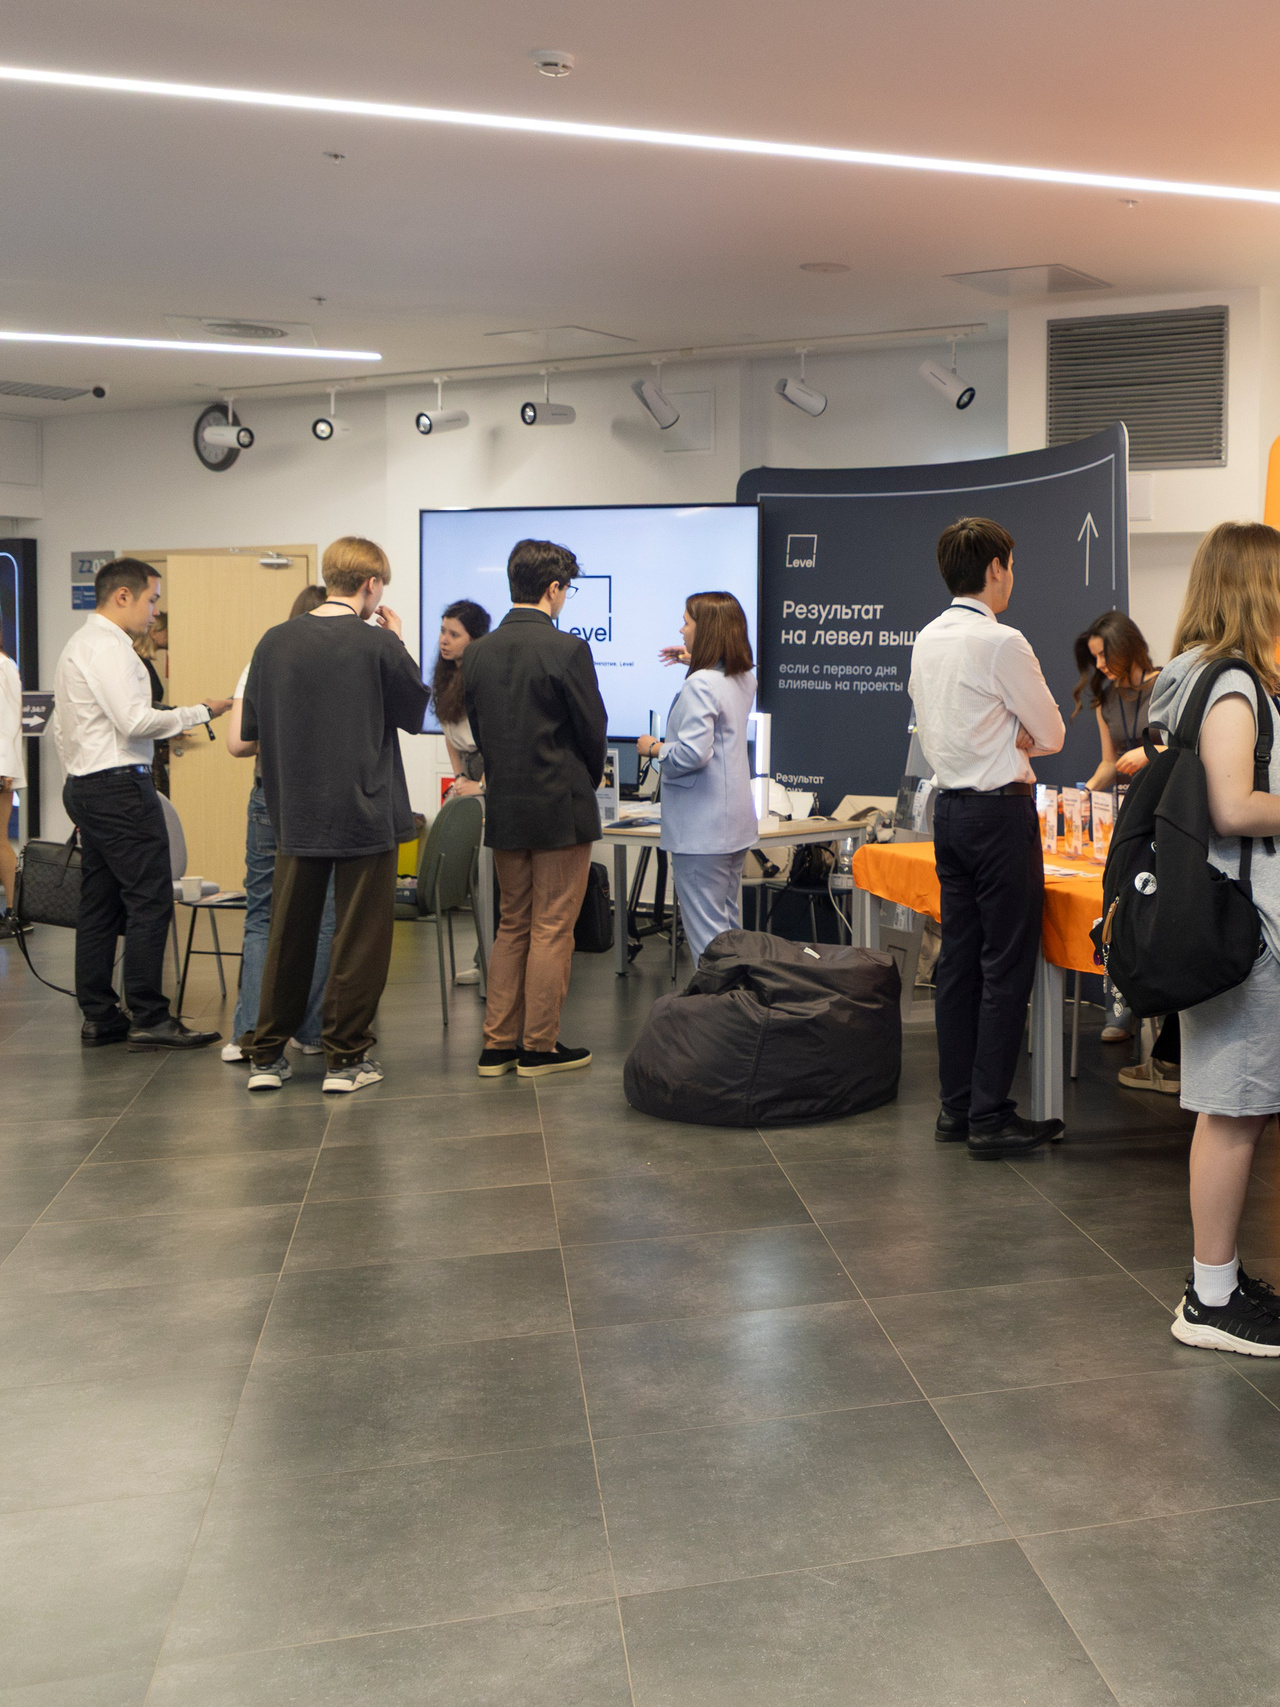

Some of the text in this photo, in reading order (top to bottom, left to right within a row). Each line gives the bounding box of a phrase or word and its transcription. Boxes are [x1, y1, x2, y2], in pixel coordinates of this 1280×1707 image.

[785, 554, 816, 568] Level
[782, 600, 884, 625] Результат
[781, 629, 919, 646] на левел выш
[779, 663, 809, 674] если
[823, 665, 872, 678] первого
[875, 666, 898, 677] дня
[778, 679, 903, 694] влияешь на проекты
[776, 772, 825, 785] Результат
